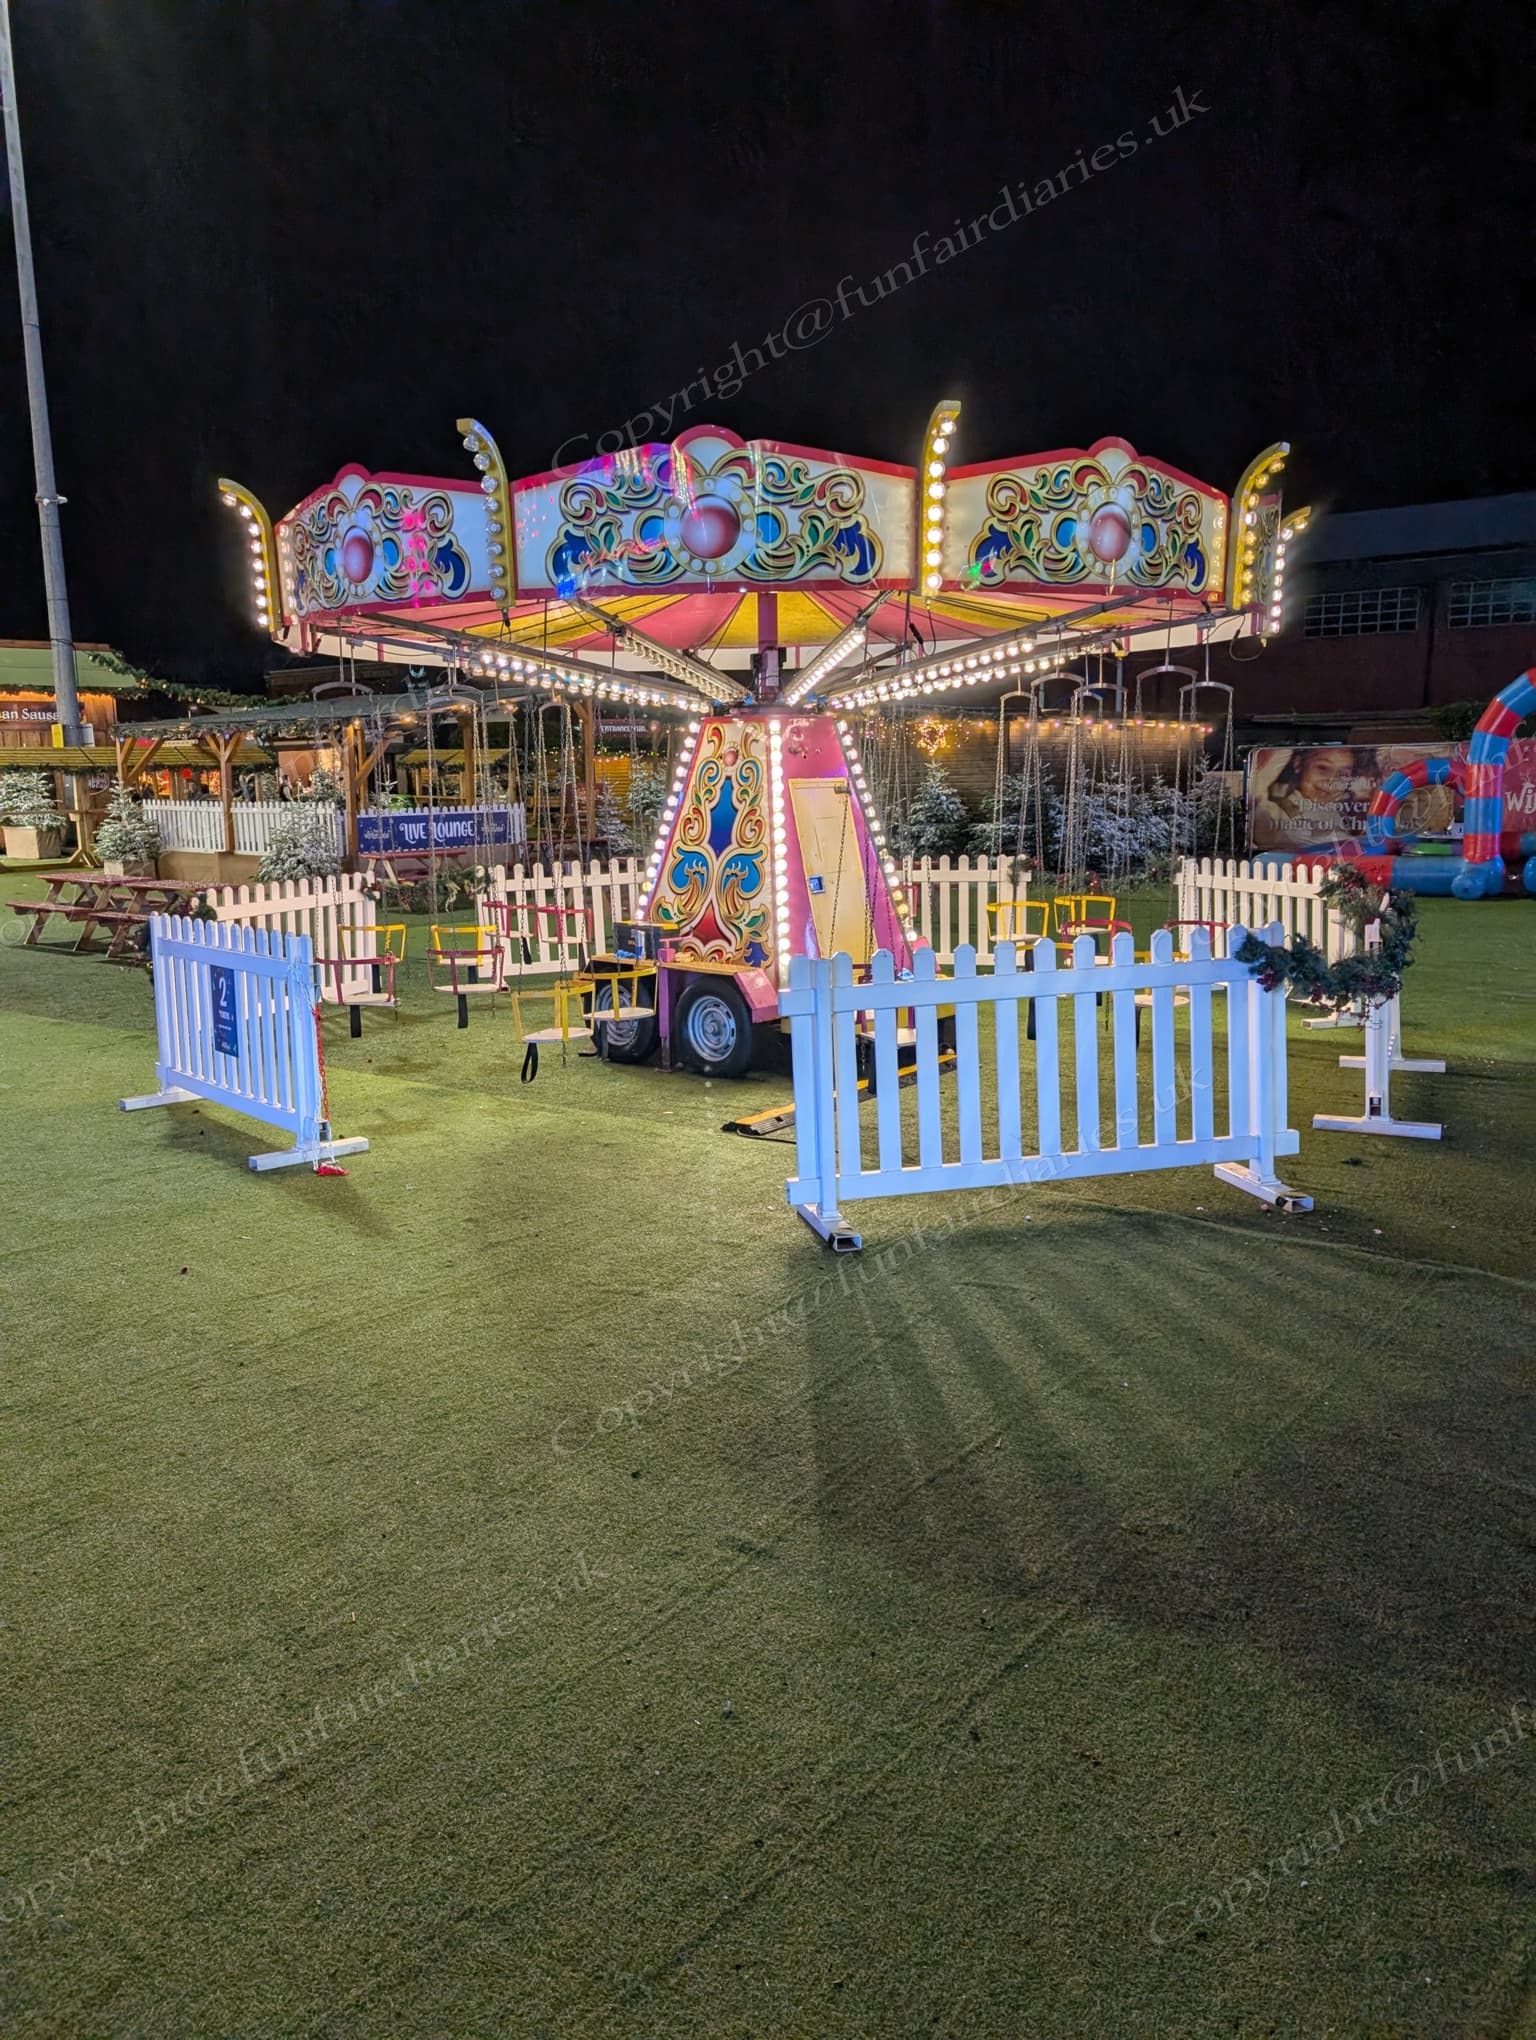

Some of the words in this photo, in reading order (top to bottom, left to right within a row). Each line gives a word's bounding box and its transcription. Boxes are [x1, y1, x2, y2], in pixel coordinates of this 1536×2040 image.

[0, 710, 18, 721] an
[1299, 799, 1371, 813] Discover
[399, 822, 427, 844] LIVE
[219, 977, 228, 1007] 2
